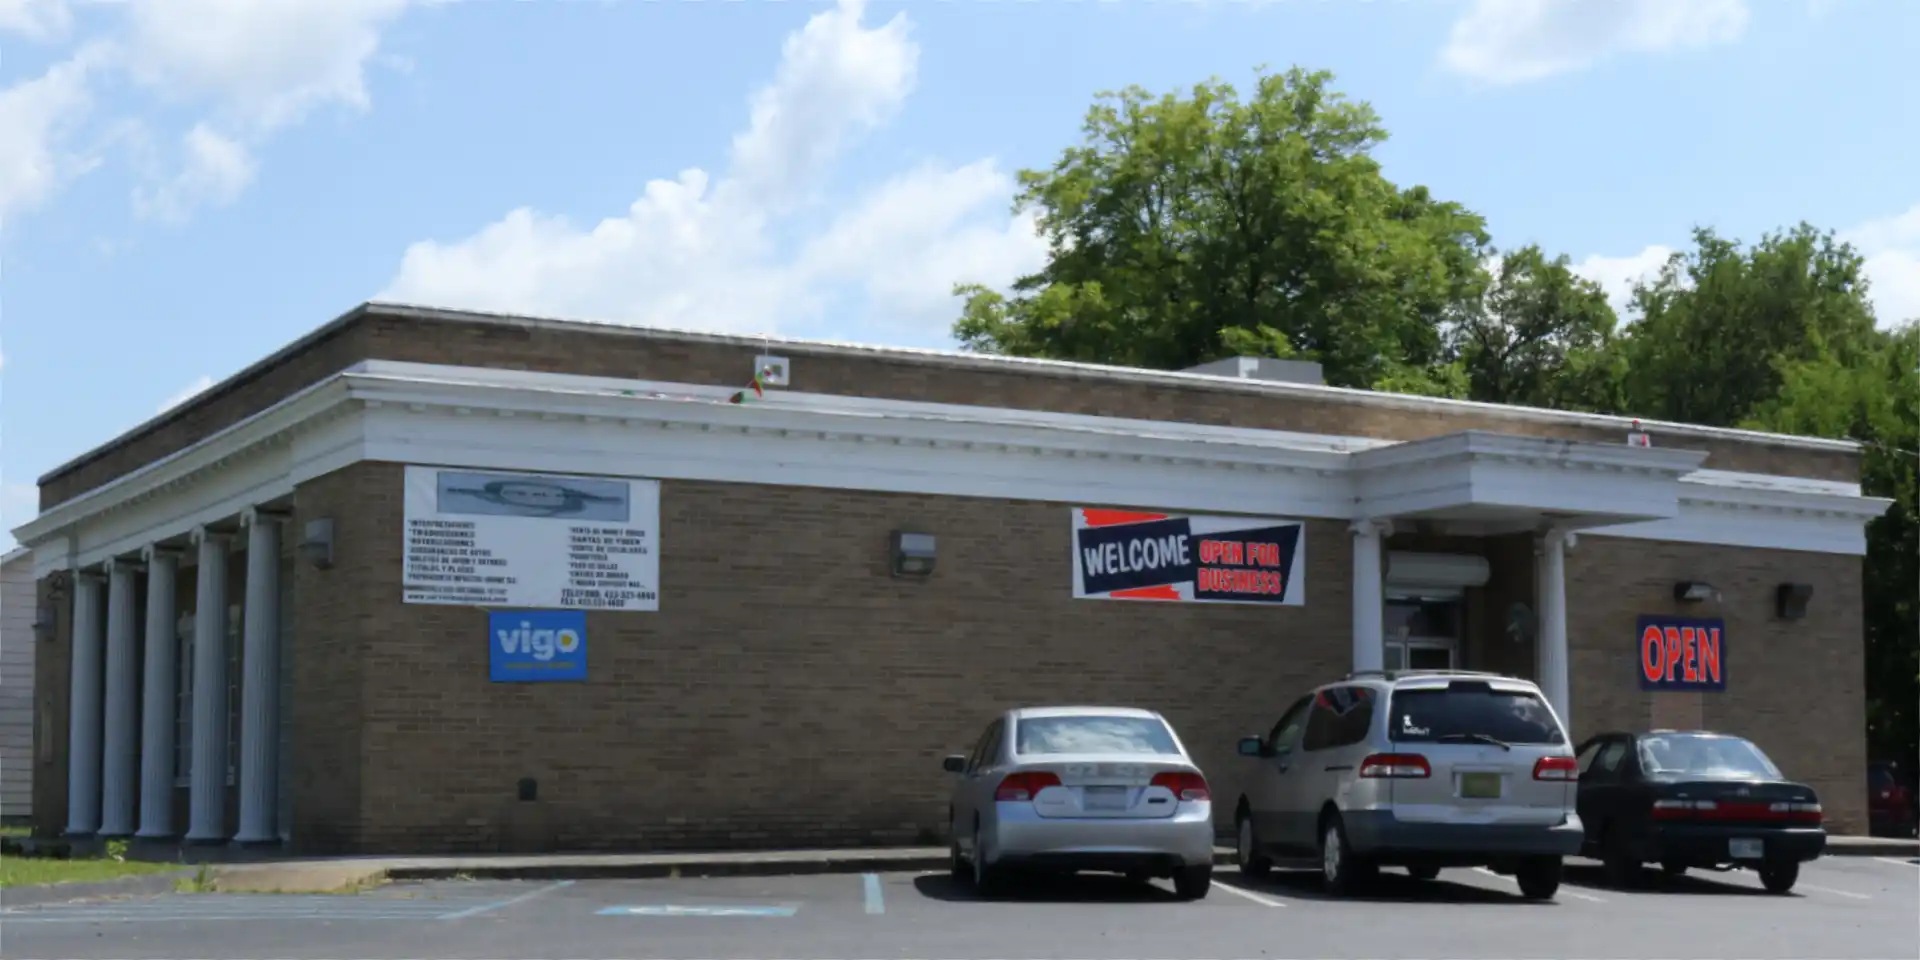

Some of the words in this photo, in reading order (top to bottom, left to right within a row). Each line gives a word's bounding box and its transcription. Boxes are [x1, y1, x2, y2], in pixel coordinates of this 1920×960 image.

[1084, 534, 1191, 577] WELCOME
[1199, 539, 1243, 565] OPEN
[1246, 542, 1281, 567] FOR
[1197, 568, 1281, 595] BUSINESS
[497, 620, 579, 661] vigo
[1642, 625, 1721, 683] OPEN
